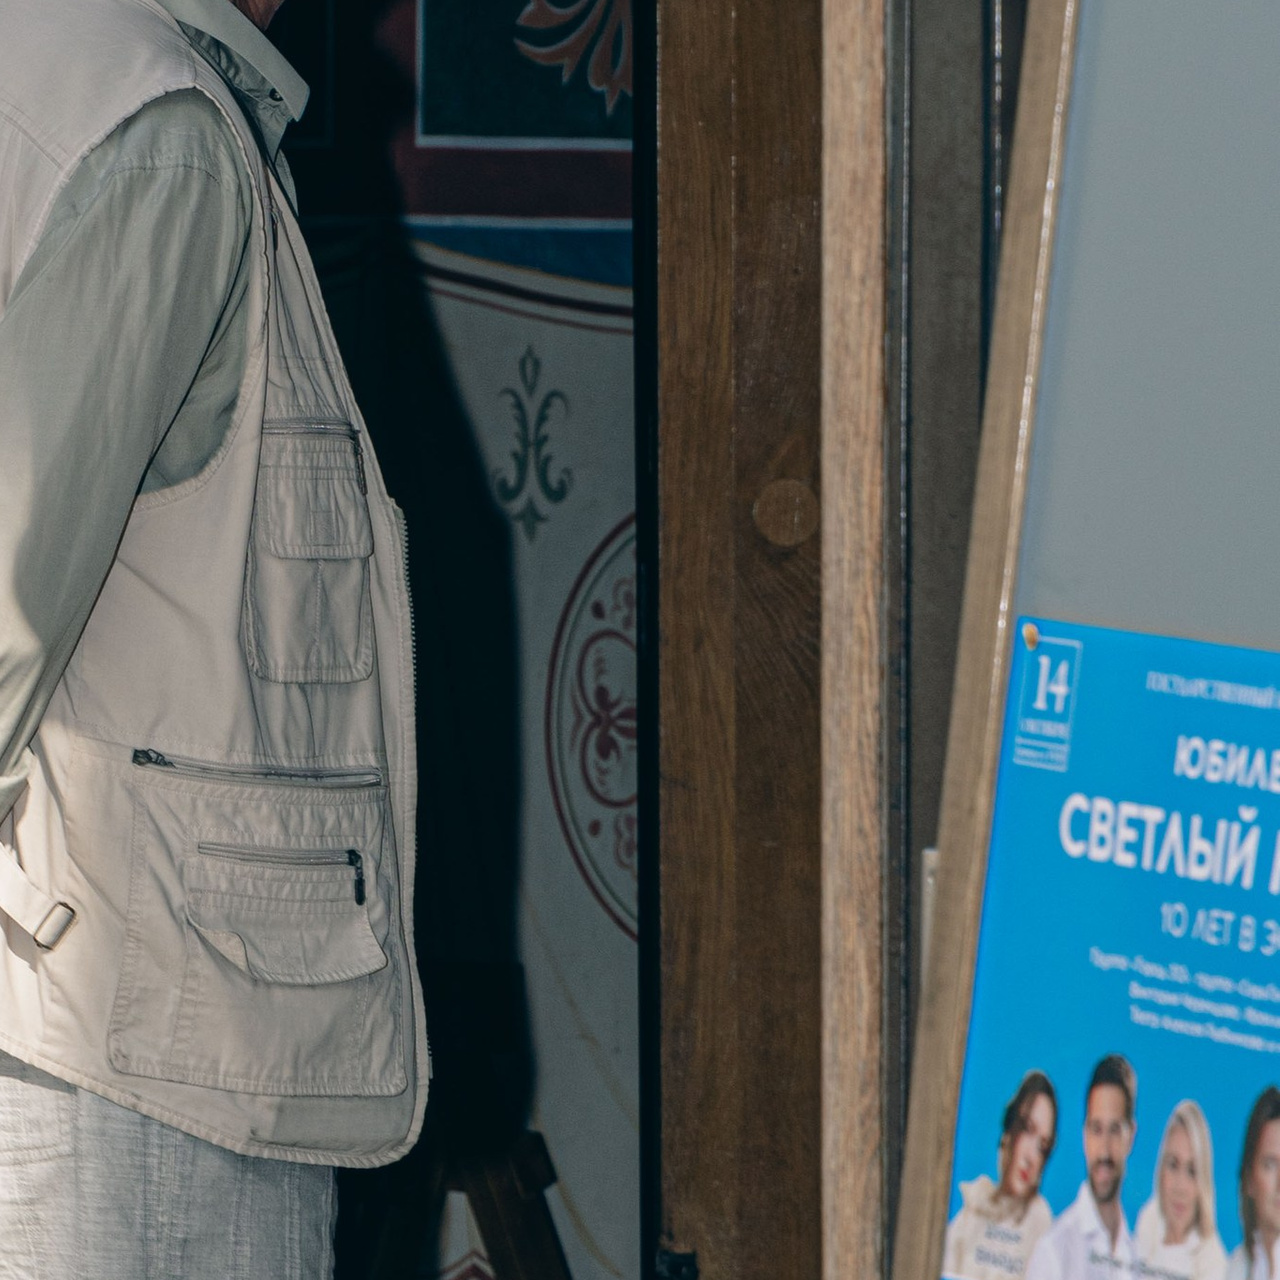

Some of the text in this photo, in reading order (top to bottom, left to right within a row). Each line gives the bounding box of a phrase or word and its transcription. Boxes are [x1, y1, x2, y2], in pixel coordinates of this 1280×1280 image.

[1033, 655, 1070, 713] 14
[1058, 792, 1261, 891] СВЕТЛЫЙ
[1160, 902, 1189, 938] 10
[1191, 908, 1236, 946] ЛЕТ
[1238, 915, 1256, 952] В
